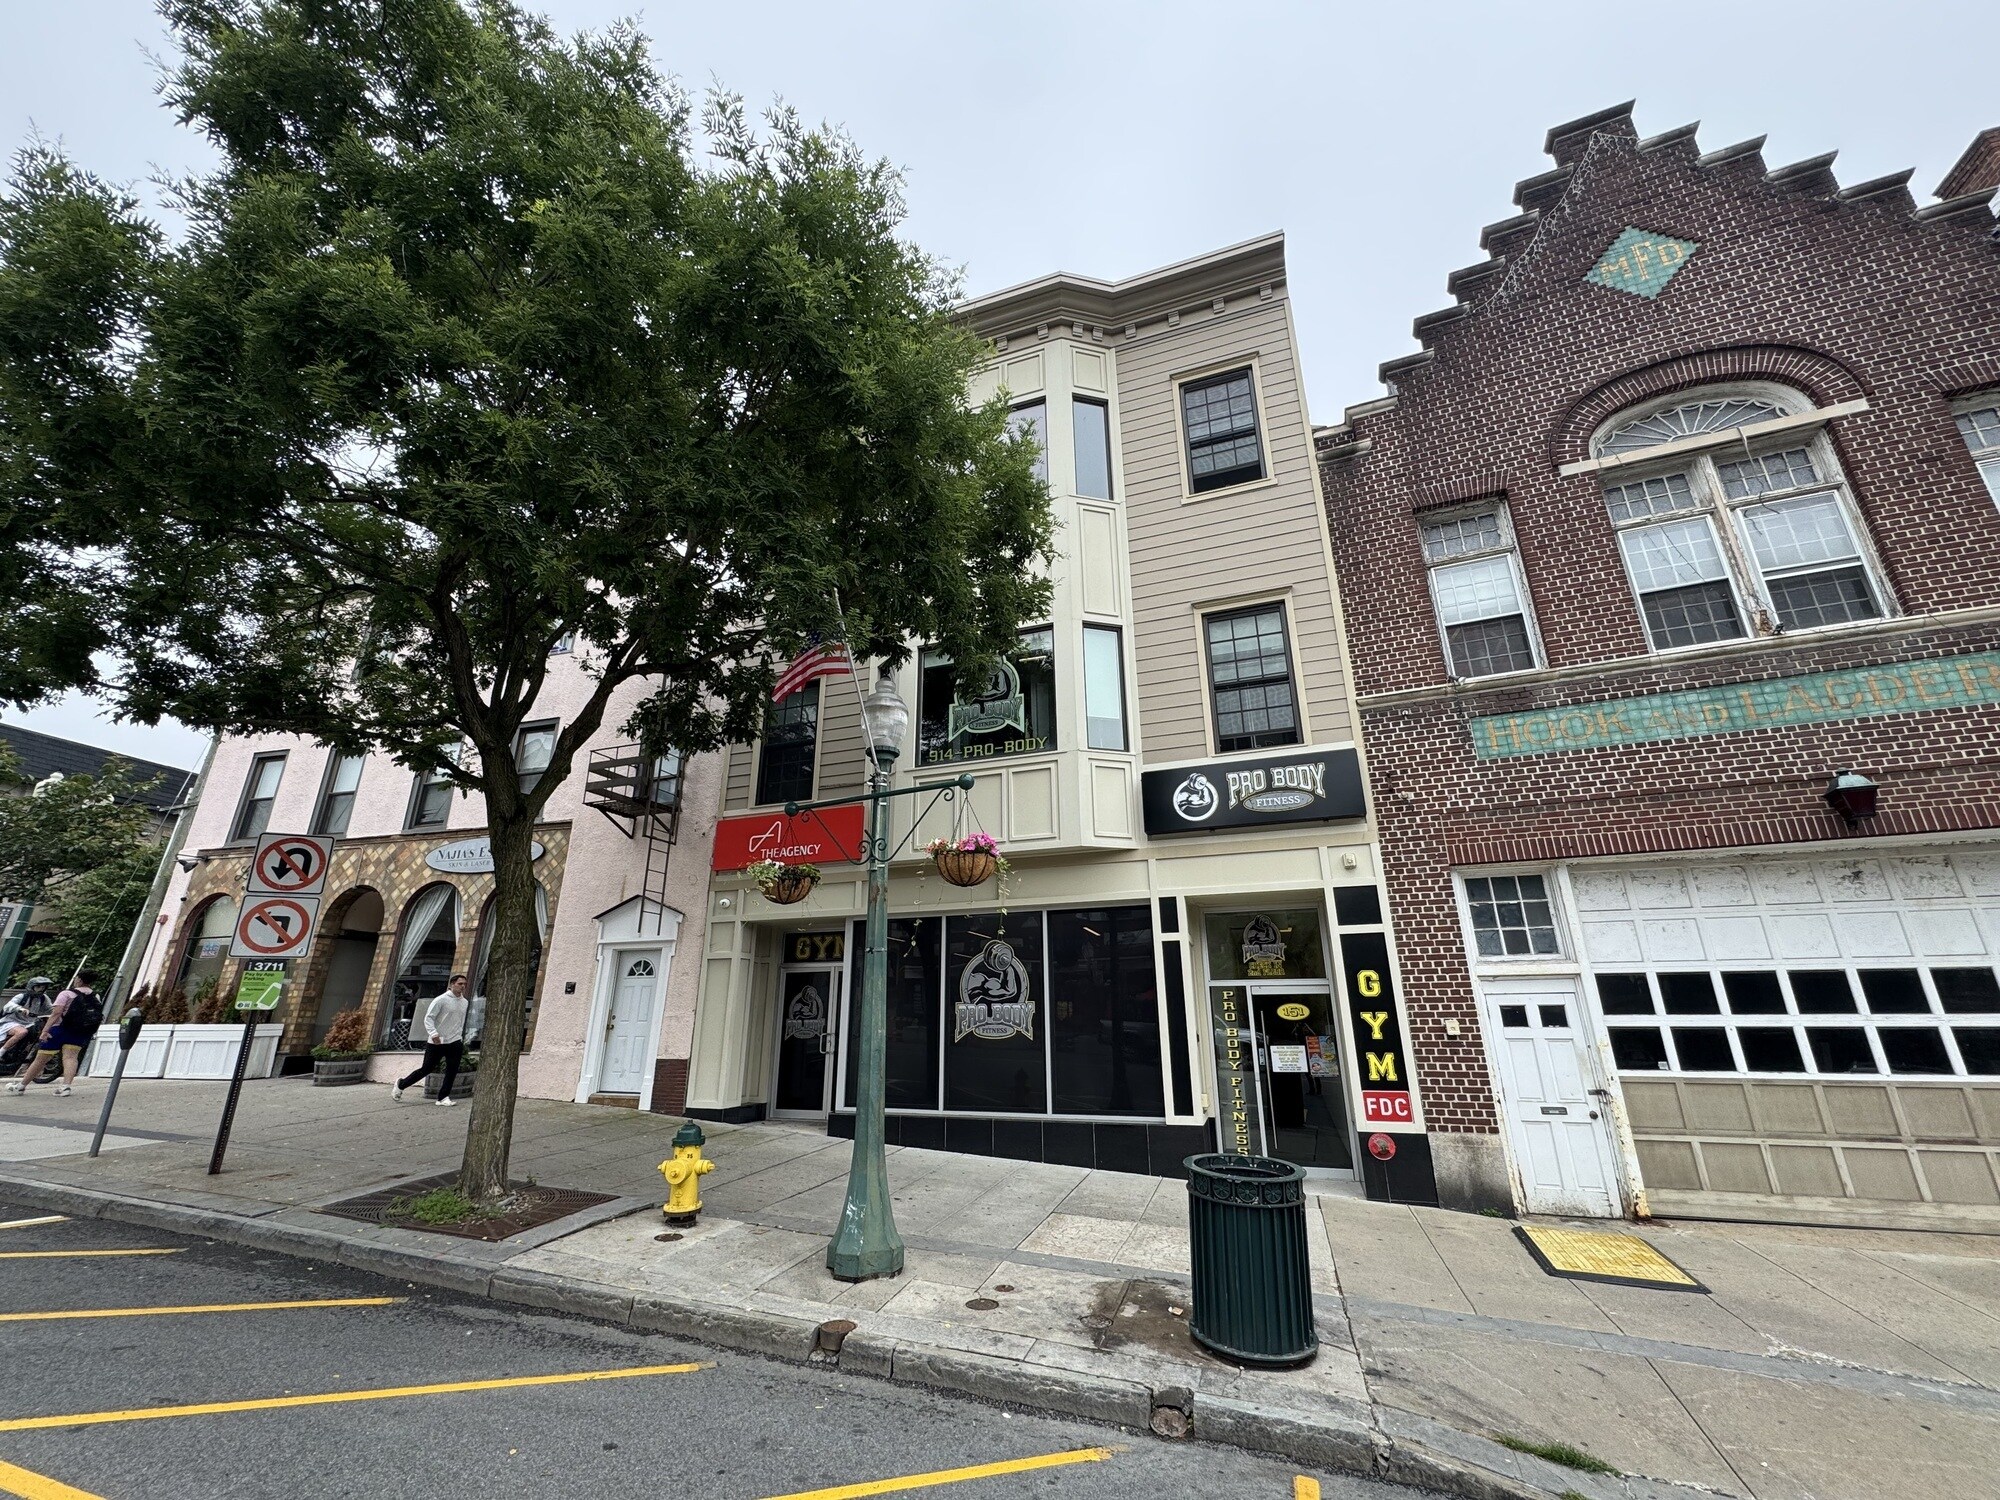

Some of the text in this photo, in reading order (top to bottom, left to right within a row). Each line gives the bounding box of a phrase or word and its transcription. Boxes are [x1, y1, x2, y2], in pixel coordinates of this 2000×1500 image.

[1600, 241, 1684, 284] MFD
[1485, 660, 2000, 750] HOOK AND LADDER
[928, 736, 1048, 763] 914-PRO-BODY
[1226, 762, 1326, 810] PRO BODY
[1256, 795, 1301, 807] FITNESS
[254, 962, 284, 971] 3711
[956, 1001, 1034, 1038] PRO BODY
[1223, 990, 1236, 1021] PRO
[1282, 1006, 1306, 1018] 151
[1356, 969, 1398, 1082] GYM
[1226, 1027, 1242, 1070] BODY
[1367, 1097, 1409, 1118] FDC
